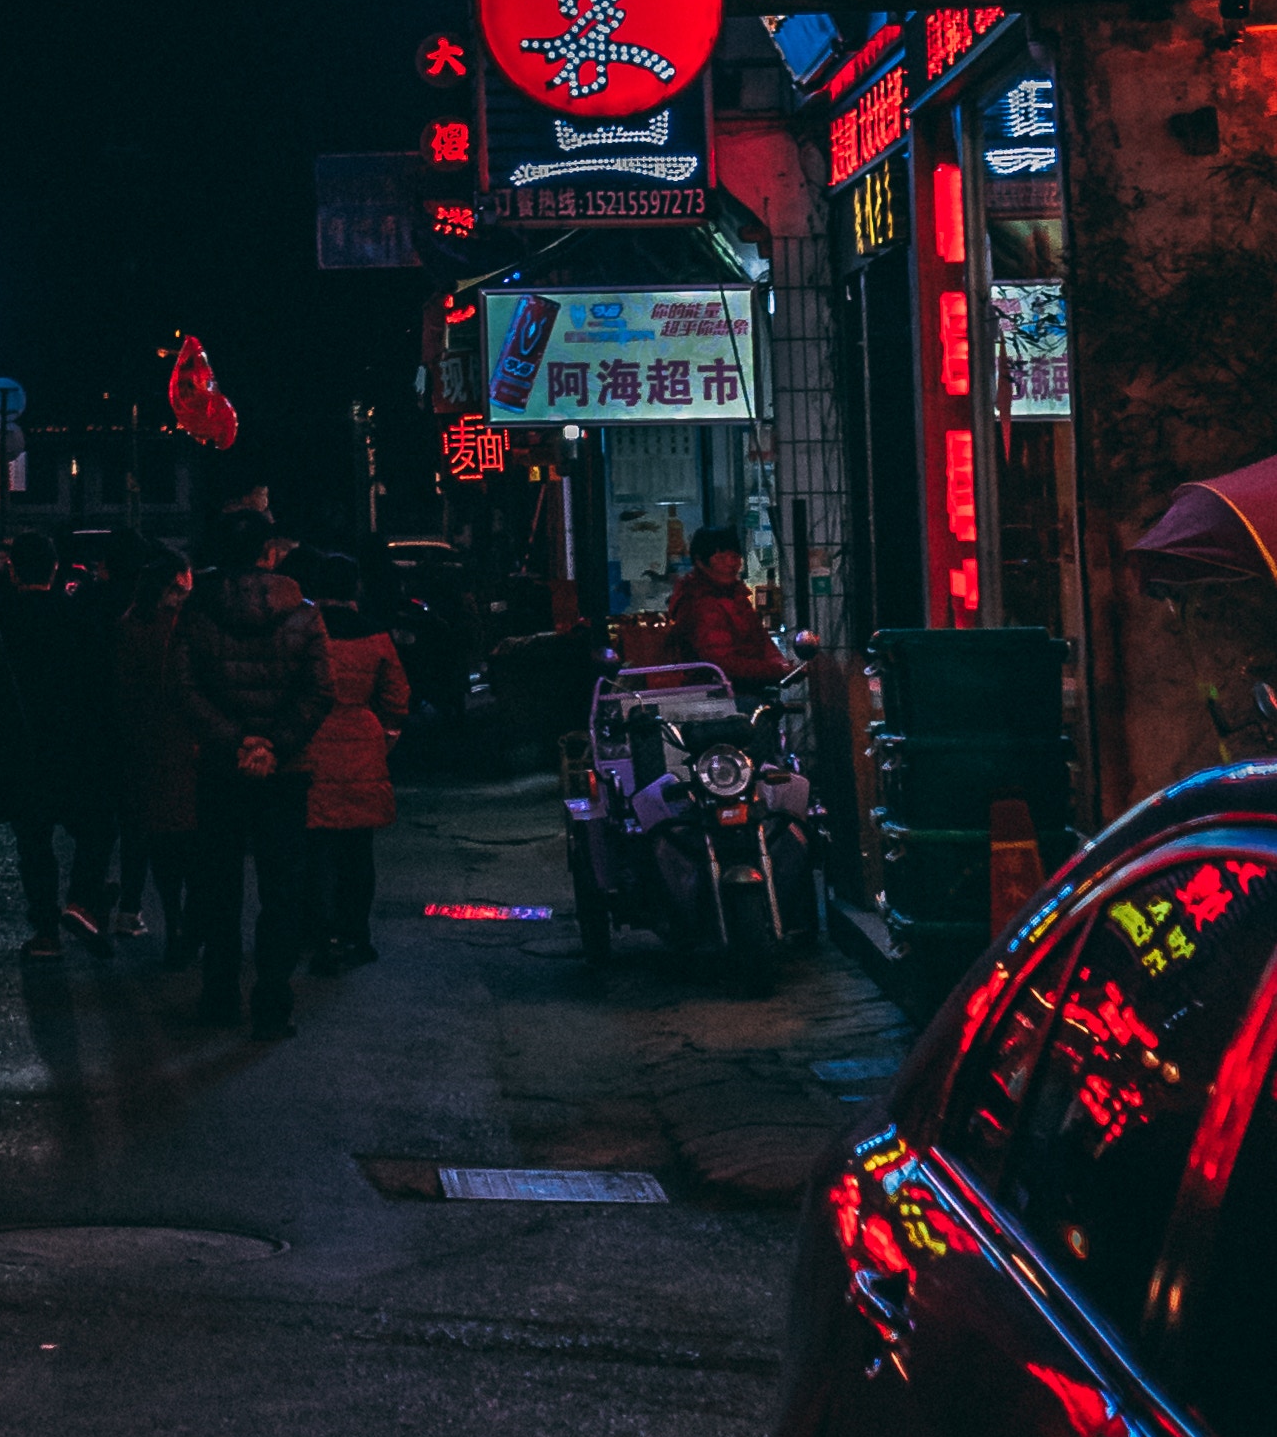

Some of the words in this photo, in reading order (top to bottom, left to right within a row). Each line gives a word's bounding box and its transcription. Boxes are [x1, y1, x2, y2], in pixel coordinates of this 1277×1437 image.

[651, 301, 722, 320] 你的能量
[547, 357, 740, 407] 阿海超市
